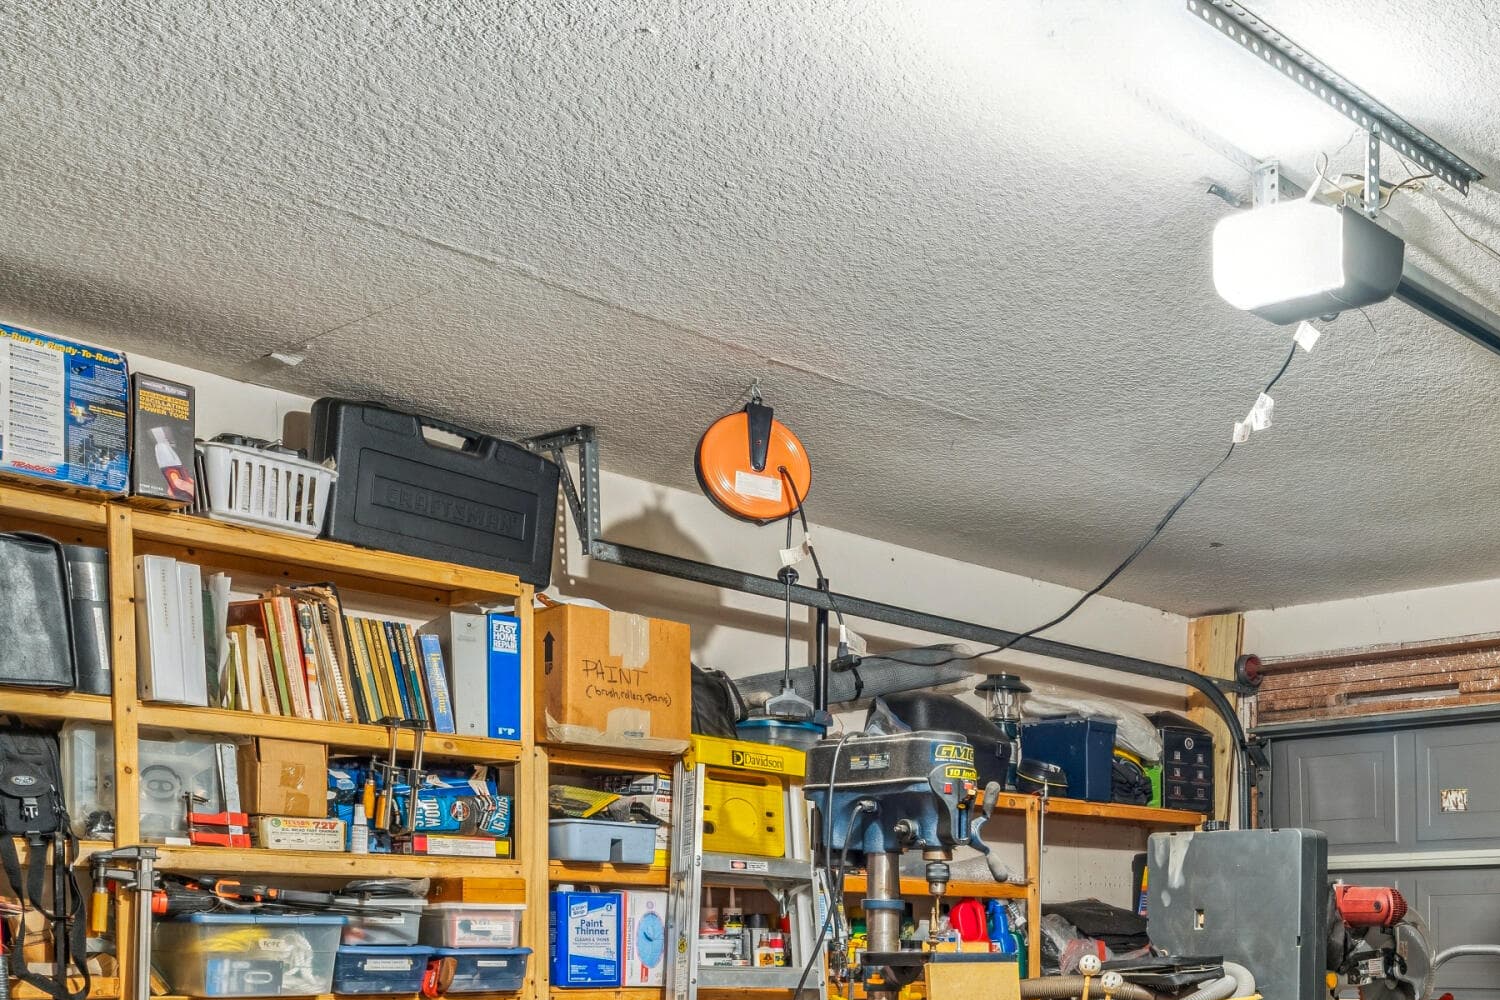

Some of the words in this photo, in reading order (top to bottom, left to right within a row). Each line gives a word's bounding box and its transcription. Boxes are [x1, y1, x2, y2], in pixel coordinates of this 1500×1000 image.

[140, 405, 166, 416] POWER
[169, 410, 189, 420] TOOL
[493, 623, 517, 634] EASY
[493, 632, 517, 642] HOME
[493, 640, 517, 650] REPAIR
[582, 659, 648, 686] PAINT
[744, 752, 783, 770] Davidson
[949, 768, 960, 777] 10
[424, 798, 441, 827] WOOL
[495, 796, 509, 819] PADS
[580, 919, 604, 928] Paint
[575, 926, 609, 935] Thinner
